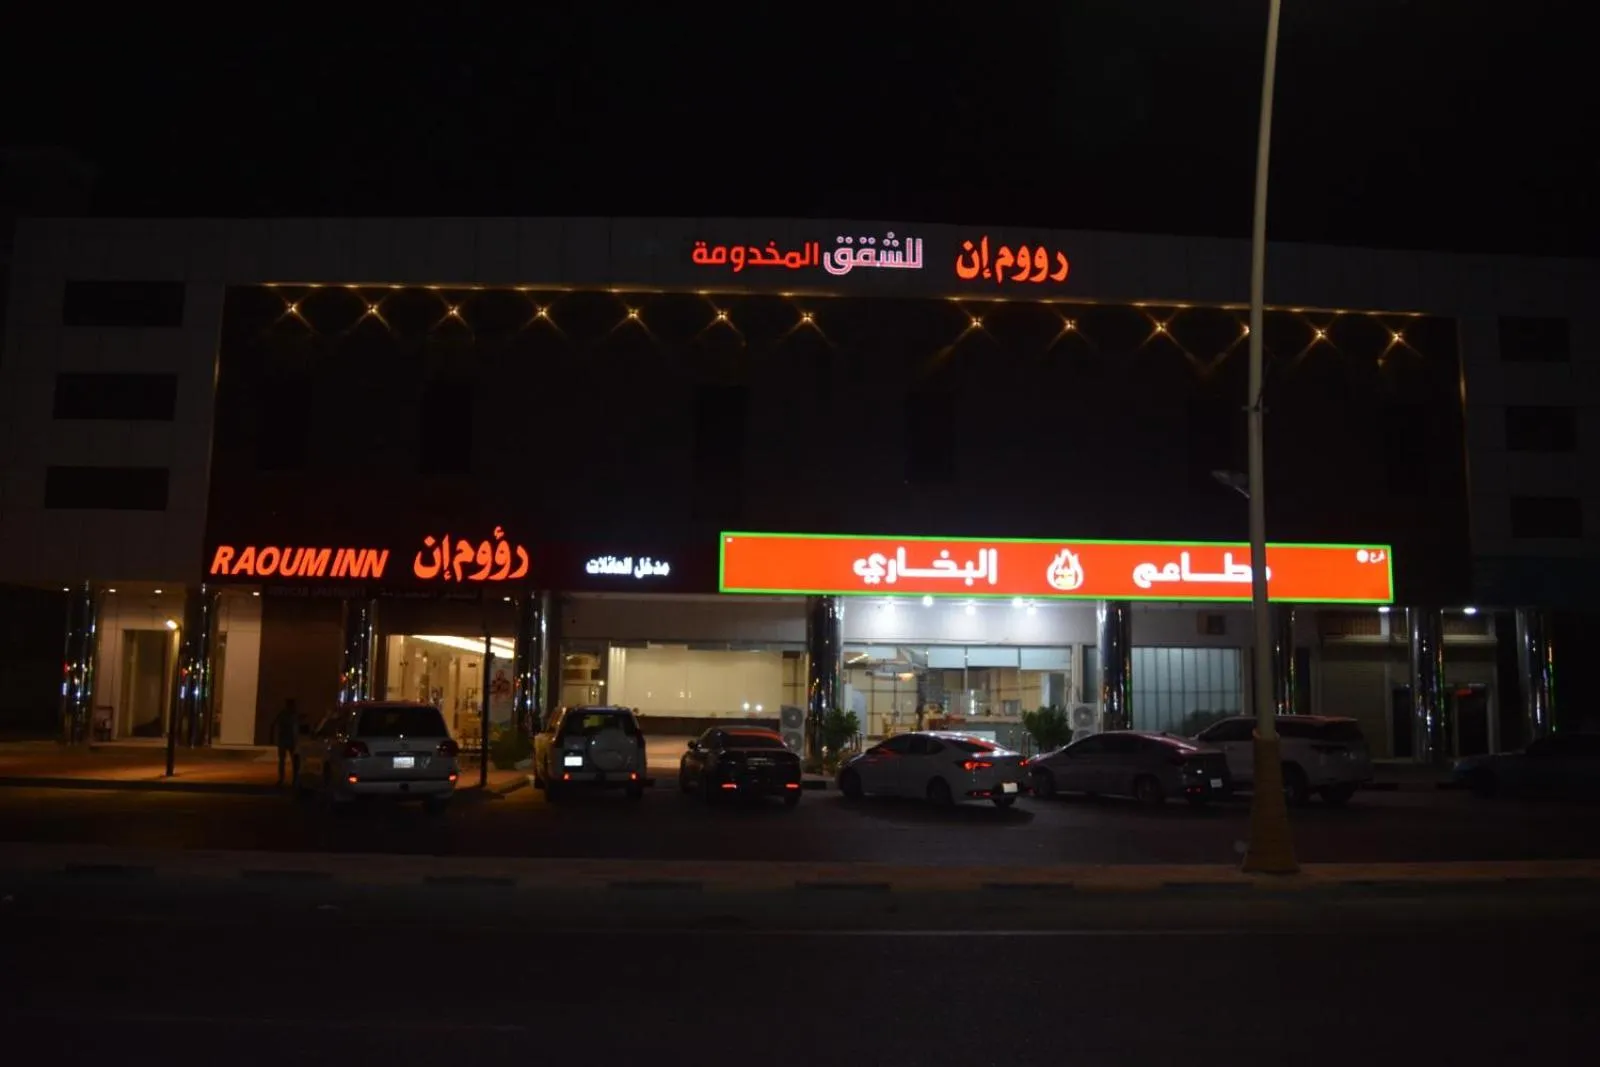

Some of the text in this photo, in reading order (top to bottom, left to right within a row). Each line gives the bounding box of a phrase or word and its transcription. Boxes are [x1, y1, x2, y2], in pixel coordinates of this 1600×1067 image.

[691, 240, 820, 274] المخدومة
[823, 231, 923, 276] للشقق
[956, 236, 992, 281] إن
[210, 545, 390, 579] RAOUM INN
[413, 532, 452, 582] إن
[852, 546, 1273, 589] طاعم البخاري
